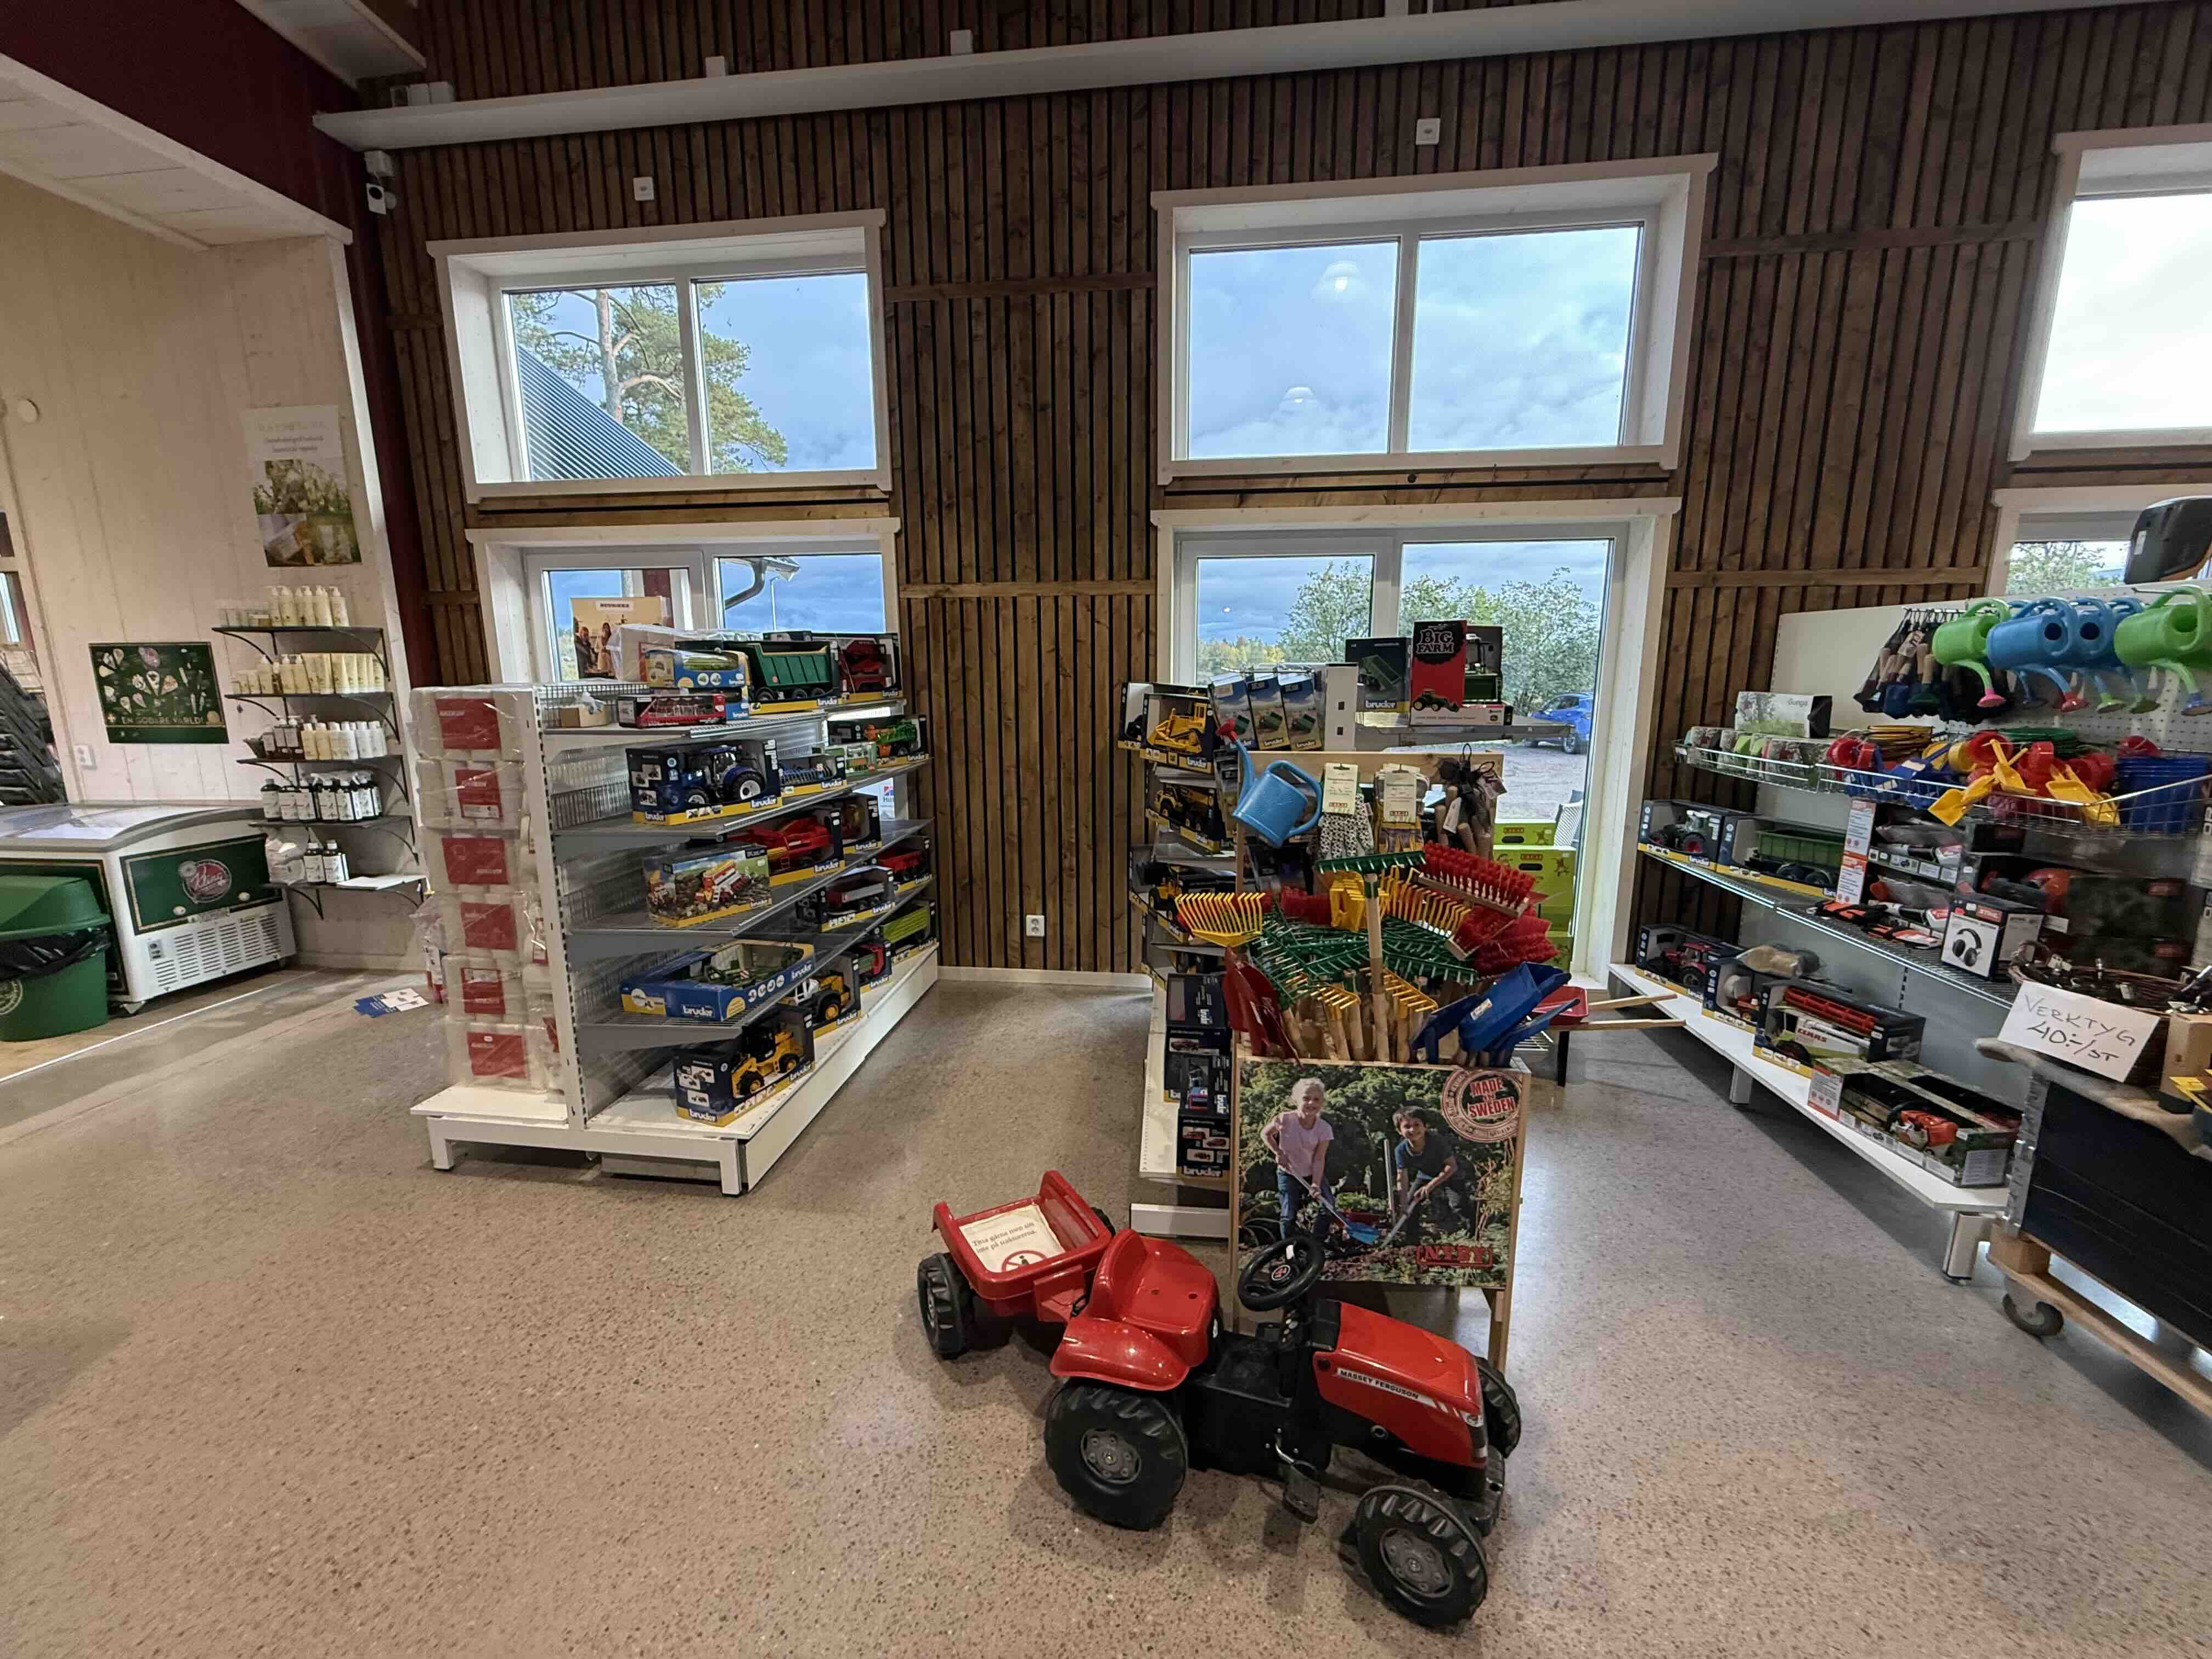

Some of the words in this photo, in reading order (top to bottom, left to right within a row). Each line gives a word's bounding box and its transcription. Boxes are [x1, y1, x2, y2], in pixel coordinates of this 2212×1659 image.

[1421, 630, 1453, 643] BIG
[1417, 644, 1454, 653] FARM
[817, 697, 838, 706] bruder
[1365, 700, 1396, 709] bruder
[752, 797, 777, 808] bruder
[645, 811, 666, 821] bruder
[815, 861, 839, 872] bruder
[683, 1005, 713, 1017] bruder
[2025, 995, 2136, 1046] VERKTYG
[1471, 1079, 1503, 1096] MADE
[1469, 1098, 1515, 1118] SWEDEN
[689, 1109, 716, 1121] bruder
[1183, 1165, 1222, 1177] bruder
[1341, 1370, 1373, 1384] MASSEY
[1375, 1380, 1419, 1399] FERGUSON
